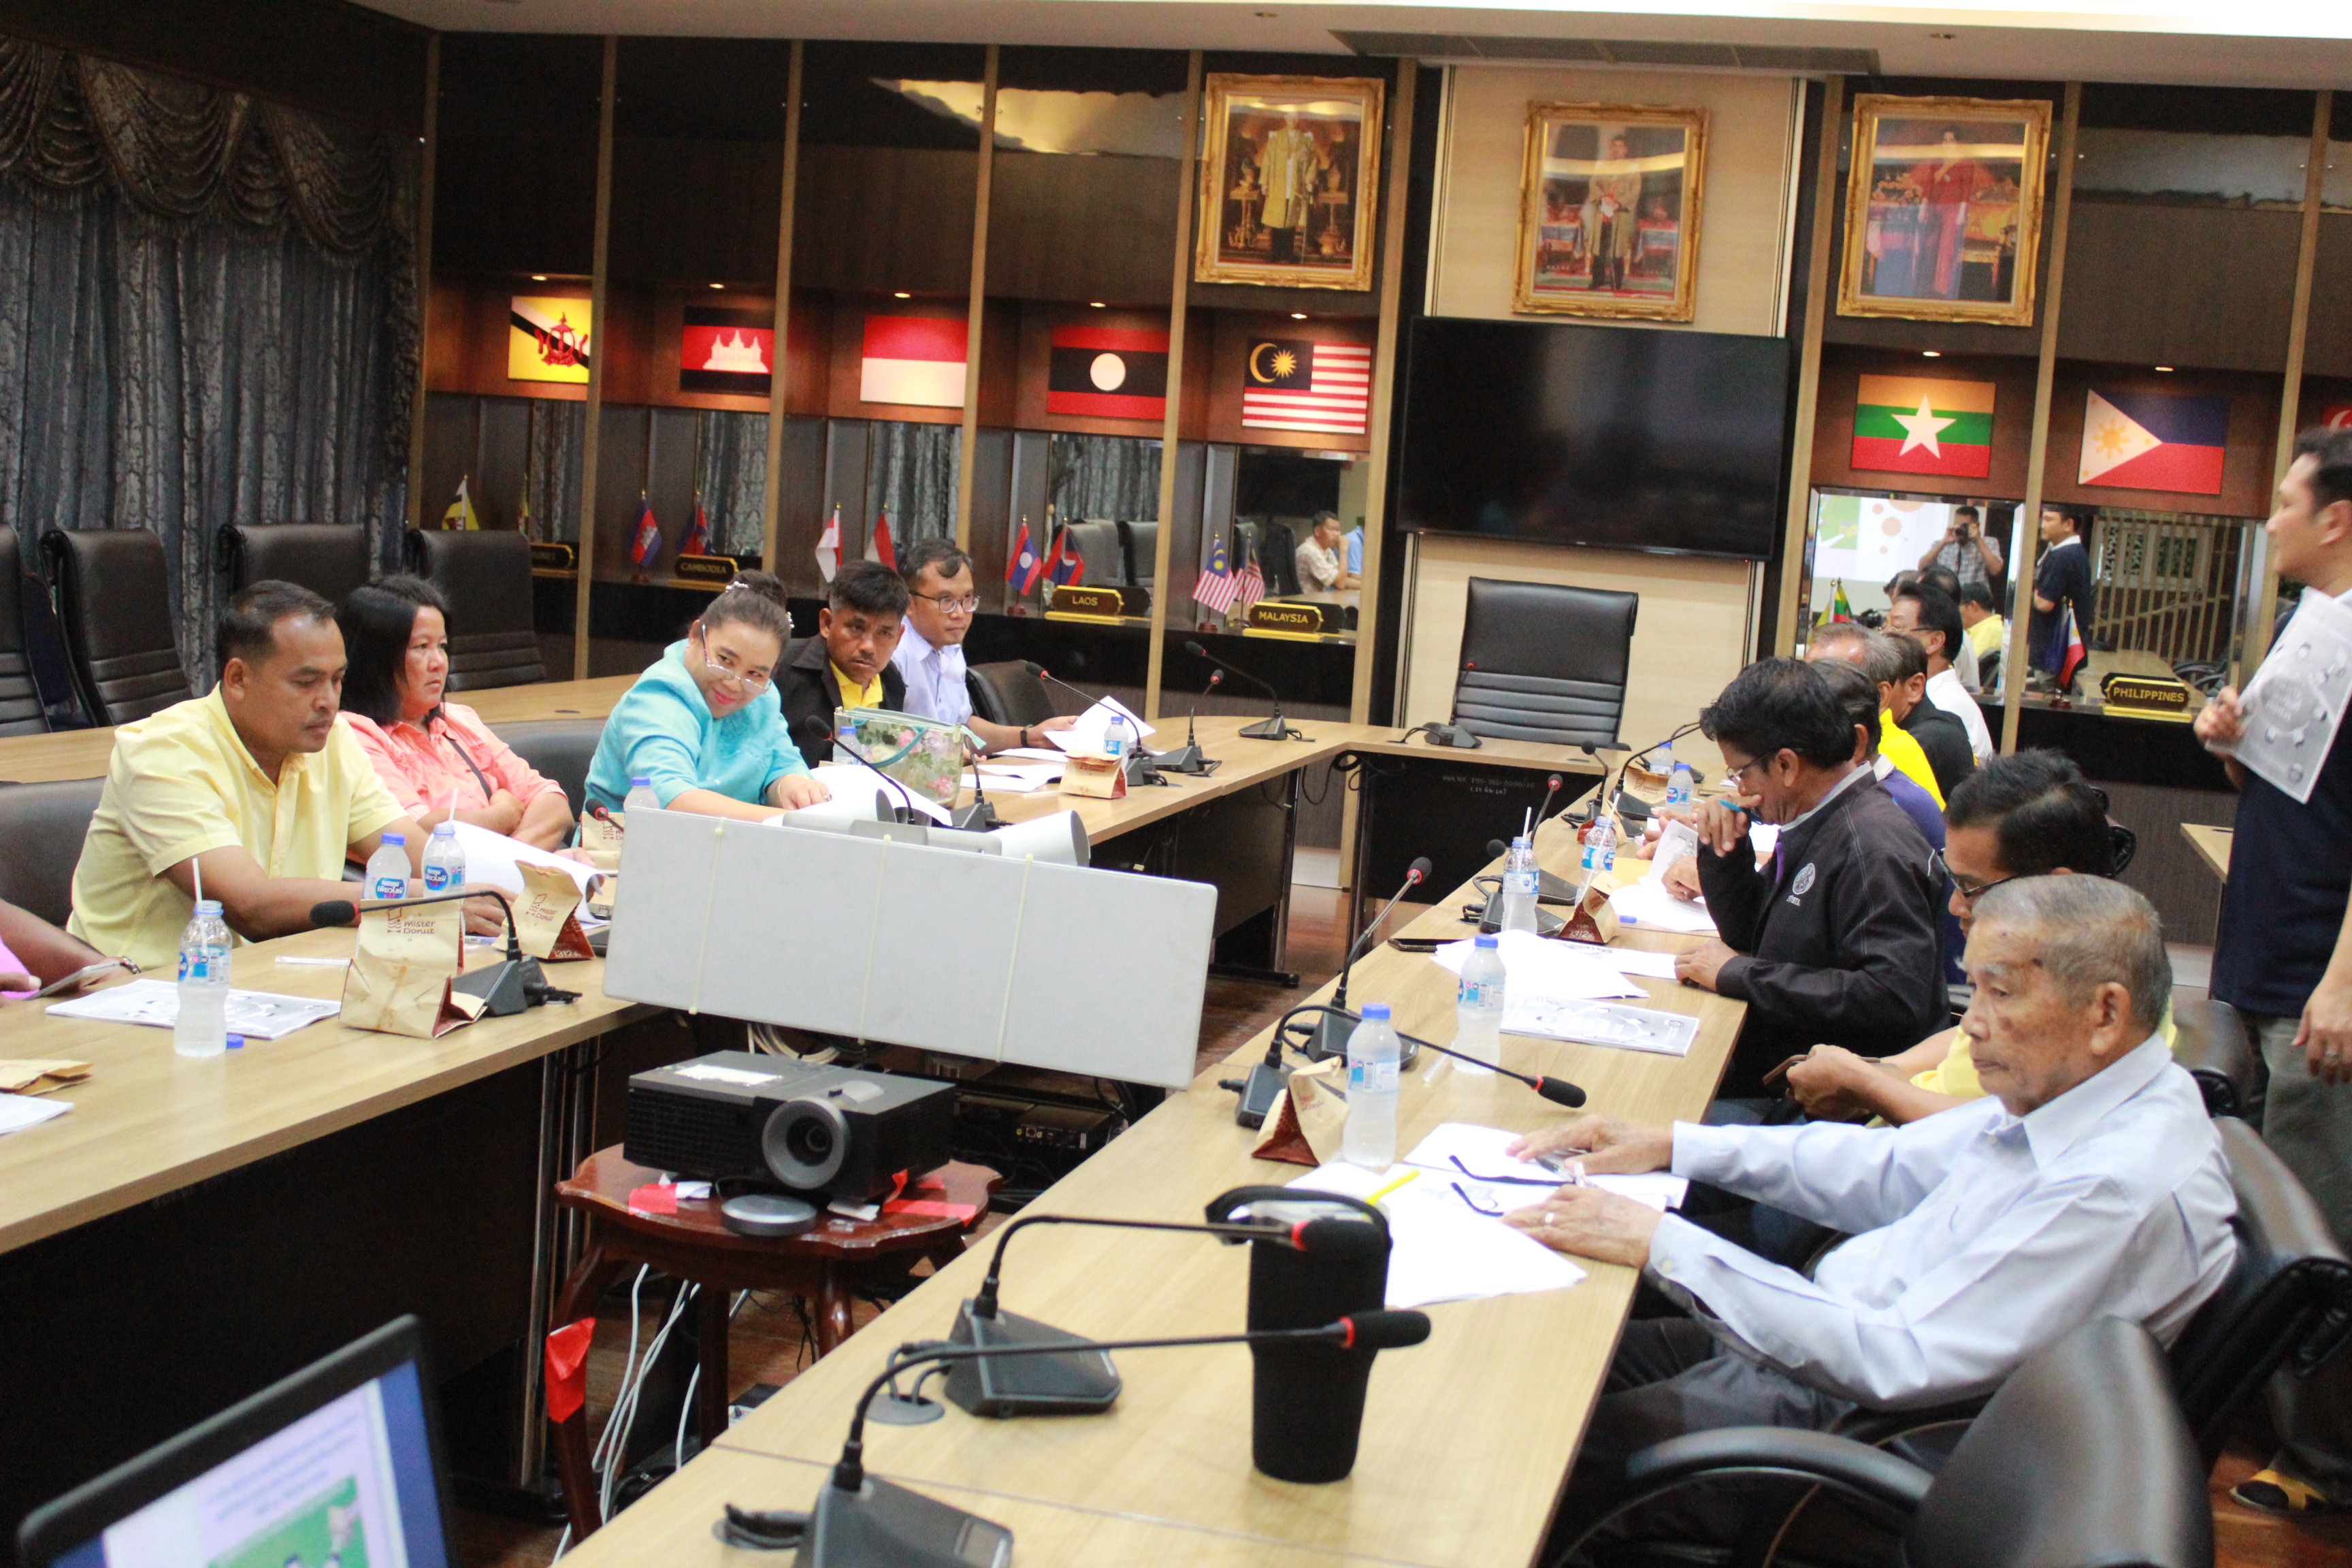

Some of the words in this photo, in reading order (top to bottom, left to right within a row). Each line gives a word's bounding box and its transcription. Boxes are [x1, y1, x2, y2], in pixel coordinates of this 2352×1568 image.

[681, 561, 727, 574] CAMBODIA
[1072, 595, 1098, 606] LAOS
[1258, 611, 1308, 624] MALAYSIA
[2113, 687, 2185, 702] PHILIPPINES
